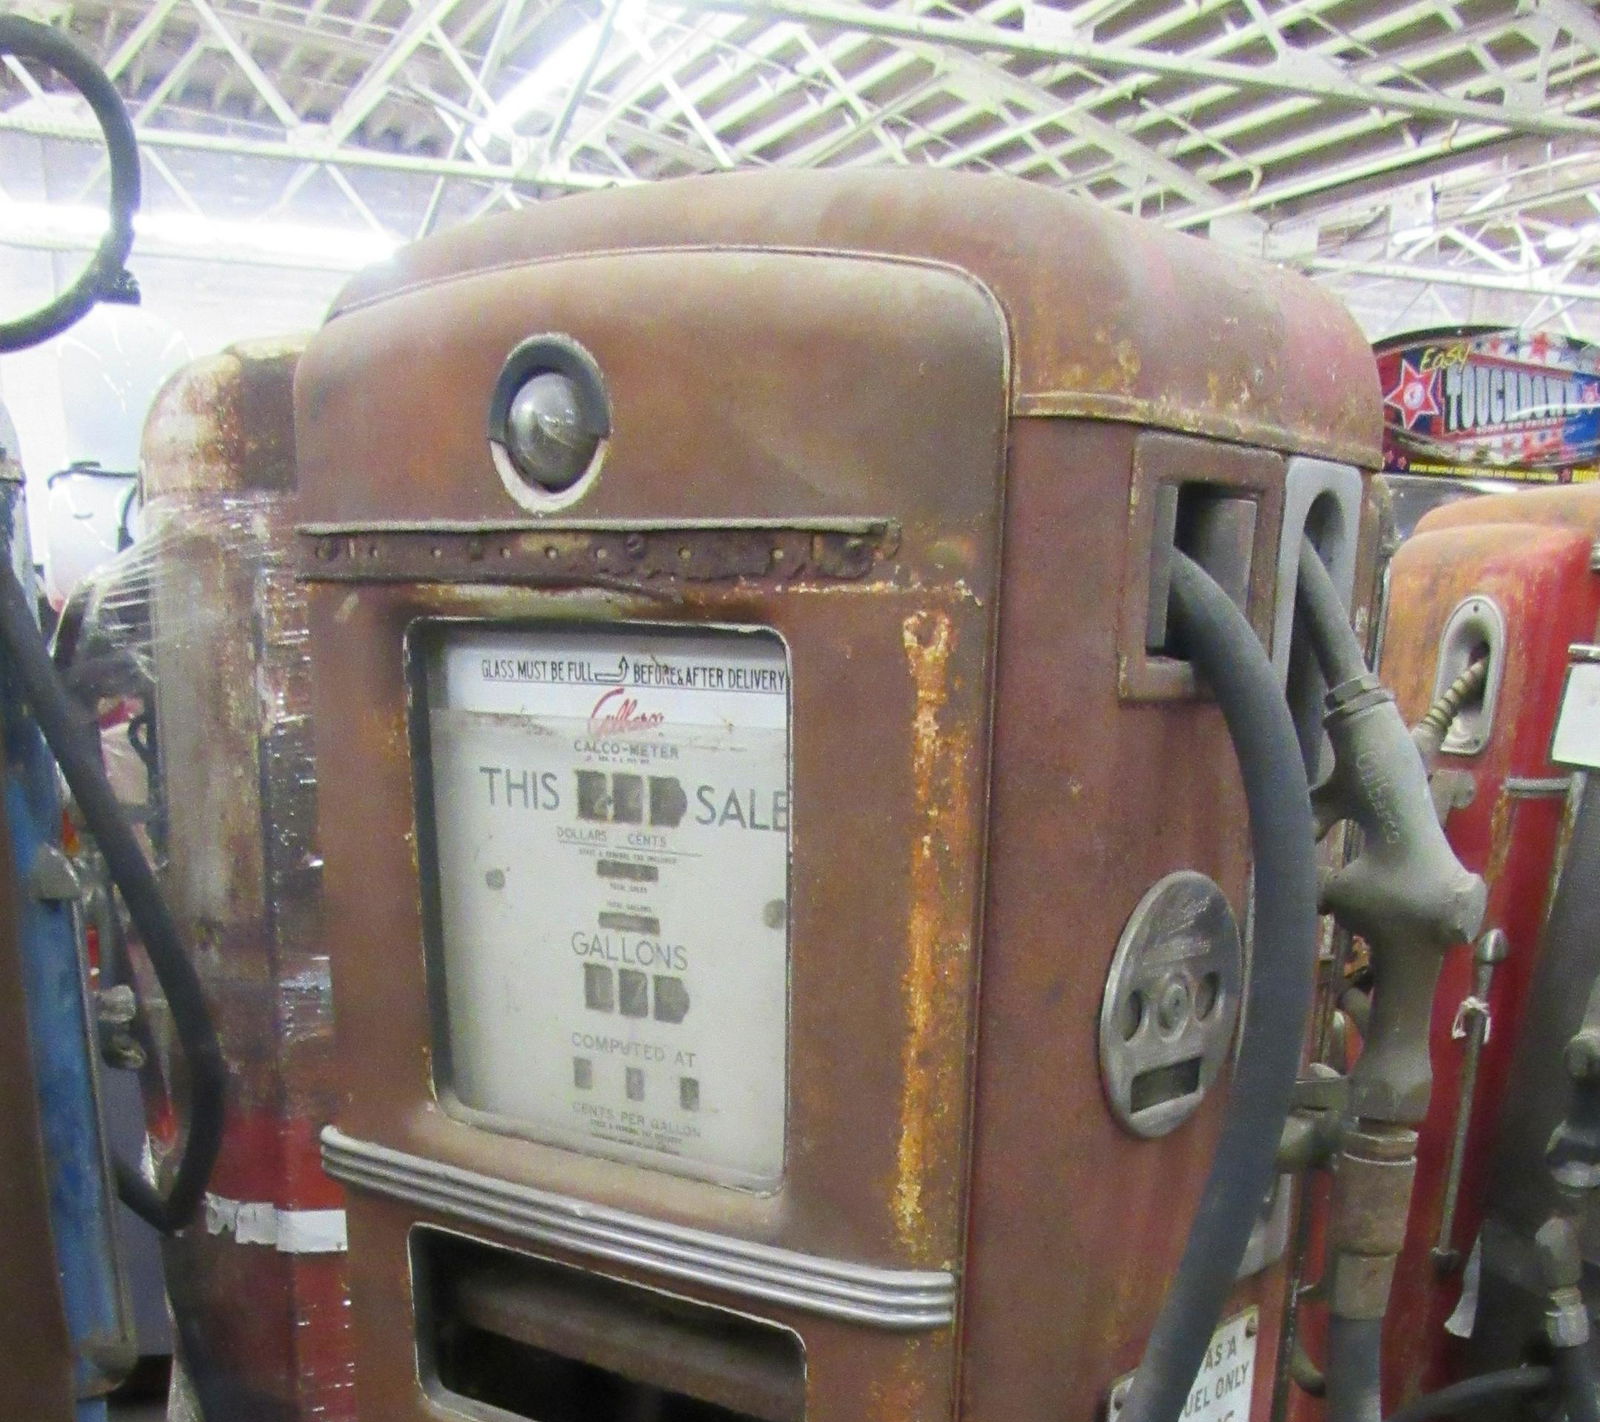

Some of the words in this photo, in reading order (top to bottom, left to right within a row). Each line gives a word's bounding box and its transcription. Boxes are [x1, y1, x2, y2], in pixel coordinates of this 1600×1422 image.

[1420, 343, 1471, 374] Easy
[482, 659, 514, 678] GLASS
[517, 661, 547, 680] MUST
[550, 661, 564, 681] BE
[567, 662, 594, 682] FULL
[633, 664, 677, 686] BEFORE
[685, 666, 724, 688] AFTER
[728, 668, 785, 691] DELIVERY
[574, 740, 679, 759] CALCO-METER
[479, 766, 560, 811] THIS
[695, 784, 787, 832] SALE
[557, 826, 608, 842] DOLLARS
[627, 833, 667, 848] CENTS
[571, 931, 689, 971] GALLONS
[571, 1032, 665, 1062] COMPUTED
[674, 1051, 696, 1068] AT
[621, 1111, 645, 1125] PER
[1204, 1343, 1223, 1373] AS
[1227, 1336, 1237, 1359] A
[1184, 1386, 1211, 1418] UEL
[1215, 1361, 1250, 1399] ONLY
